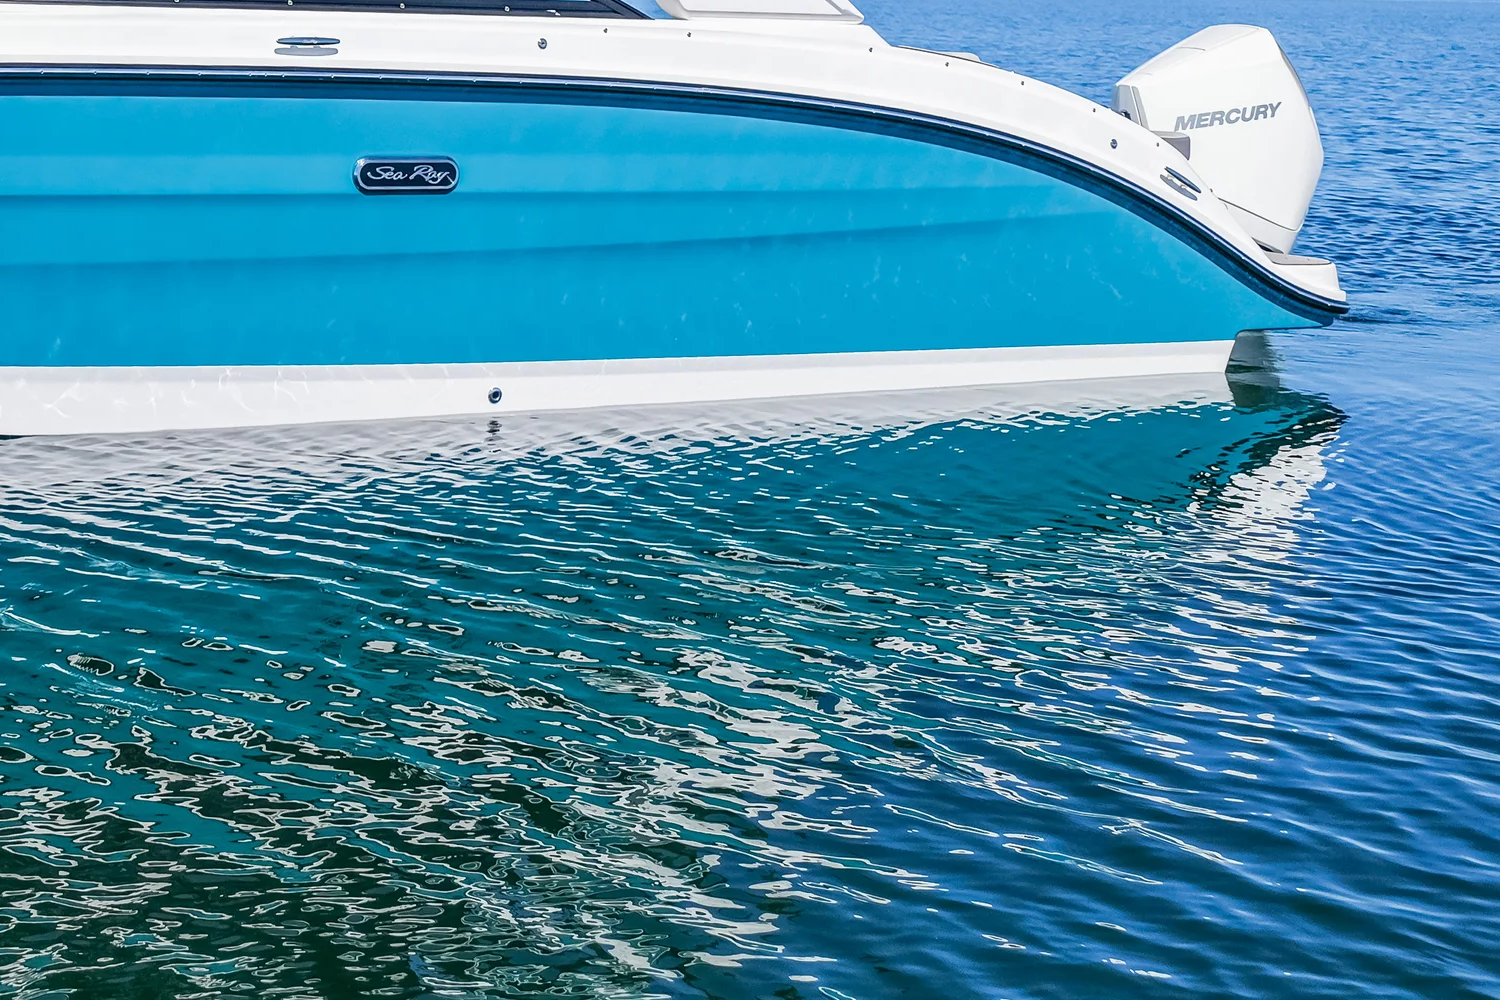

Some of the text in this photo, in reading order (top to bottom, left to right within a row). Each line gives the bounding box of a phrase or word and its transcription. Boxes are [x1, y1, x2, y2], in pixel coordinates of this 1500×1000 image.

[1173, 101, 1283, 132] MERCURY
[366, 164, 451, 185] Sea Ray
